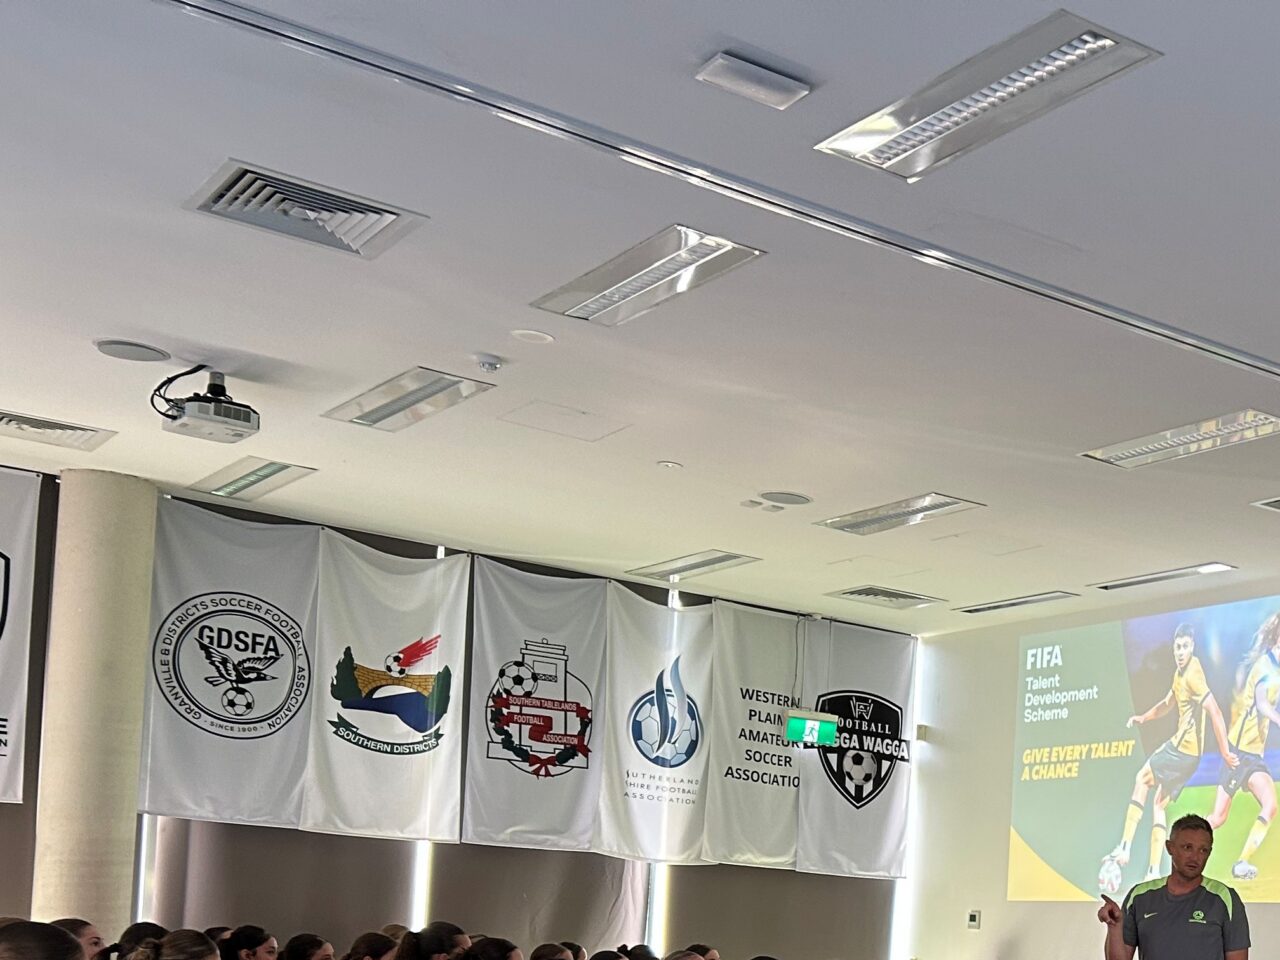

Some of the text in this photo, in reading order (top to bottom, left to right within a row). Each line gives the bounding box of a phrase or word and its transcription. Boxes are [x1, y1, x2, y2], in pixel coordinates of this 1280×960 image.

[210, 597, 262, 613] SOCCER
[163, 601, 209, 646] DISTRICTS
[198, 624, 281, 657] GDSFA
[1026, 645, 1062, 670] FIFA
[160, 659, 202, 720] GRANVILLE
[1025, 674, 1060, 690] Talent
[267, 665, 306, 730] ASSOCIATION
[509, 696, 577, 711] SOUTHERN TABLELANDS
[740, 687, 800, 708] WESTERN
[1025, 685, 1098, 706] Development
[513, 714, 544, 725] FOOTBALL
[748, 709, 783, 727] PLAIN
[1024, 707, 1068, 722] Scheme
[837, 718, 892, 735] OOTBALL
[337, 727, 438, 753] SOUTHERN DISTRICTS
[542, 734, 578, 744] ASSOCIATION
[738, 728, 800, 748] AMATEUR
[863, 735, 909, 760] WAGGA
[745, 749, 793, 767] SOCCER
[1023, 740, 1135, 764] GIVE EVERY TALENT
[724, 766, 800, 788] ASSOCIATIO
[1021, 762, 1079, 781] A CHANCE
